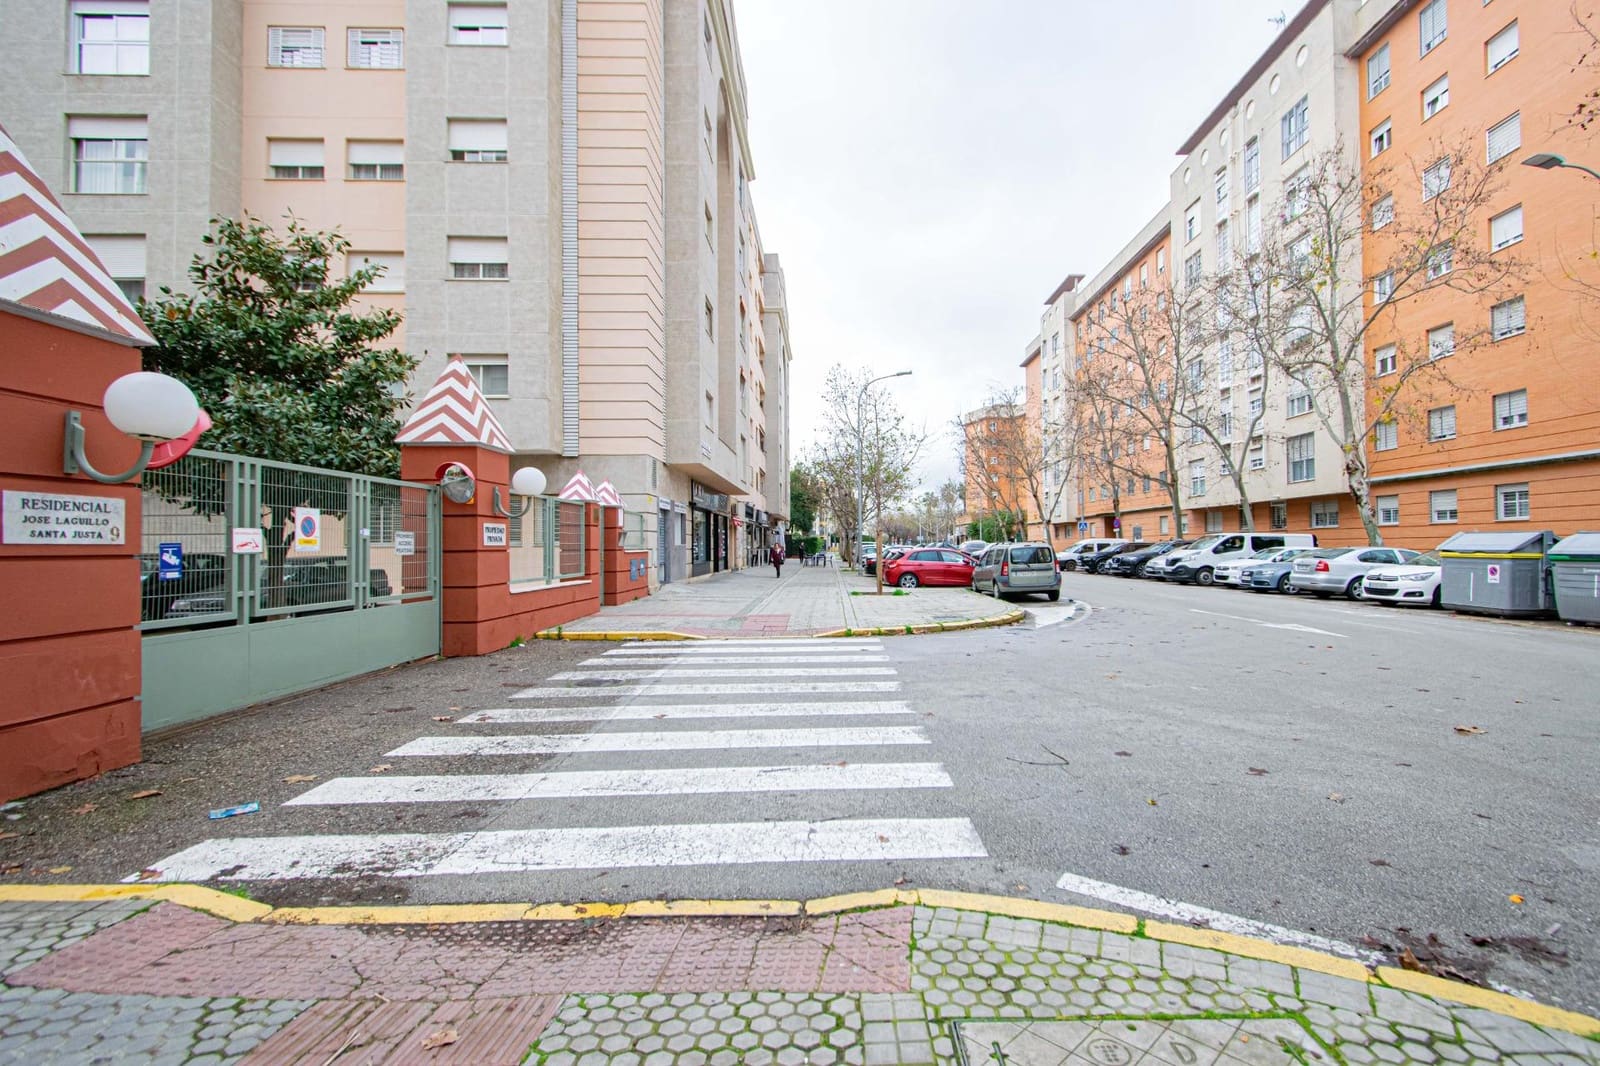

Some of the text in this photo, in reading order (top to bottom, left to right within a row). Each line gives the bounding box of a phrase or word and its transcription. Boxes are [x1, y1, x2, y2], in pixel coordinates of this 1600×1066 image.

[21, 498, 112, 514] RESIDENCIAL
[22, 515, 110, 526] JOSE LAGUILLO
[29, 530, 104, 540] SANTA JUSTA
[110, 526, 120, 542] 9
